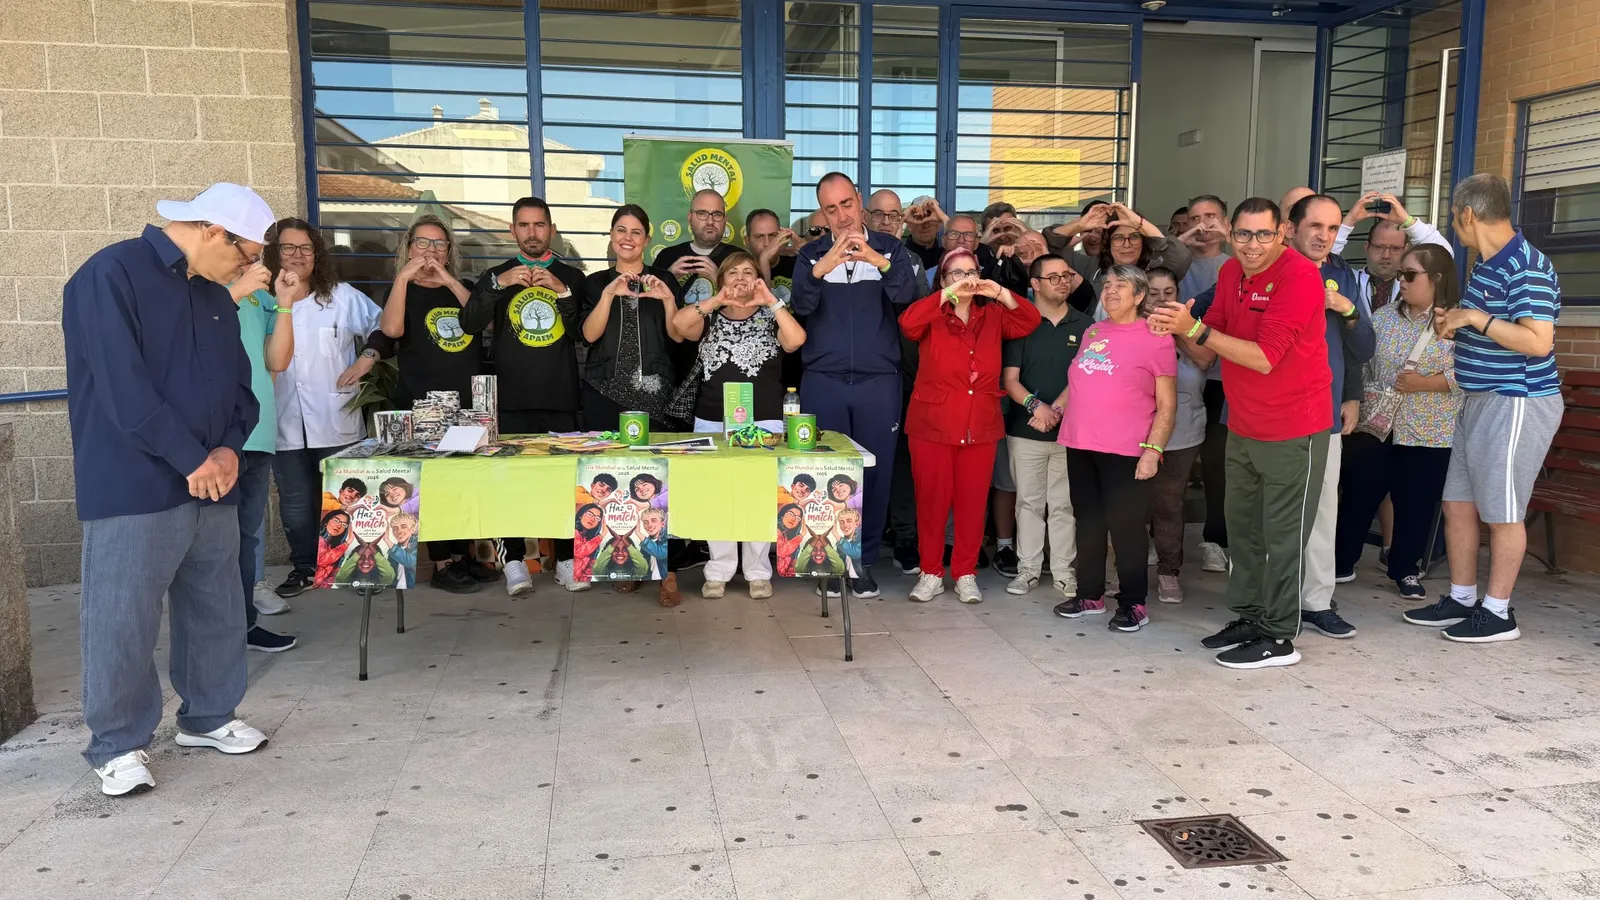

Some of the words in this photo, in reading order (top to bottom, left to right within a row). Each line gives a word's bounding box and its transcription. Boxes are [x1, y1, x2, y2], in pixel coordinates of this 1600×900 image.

[686, 153, 708, 178] SALUD
[710, 153, 737, 183] MENTAL
[513, 292, 535, 315] SALUD
[430, 311, 443, 325] SALUD
[442, 339, 467, 348] APAEM
[522, 333, 555, 342] APAEM
[608, 502, 624, 513] Haz
[808, 503, 822, 512] Haz
[357, 509, 374, 519] Haz
[608, 509, 636, 522] match
[808, 510, 833, 522] match
[355, 515, 386, 528] match
